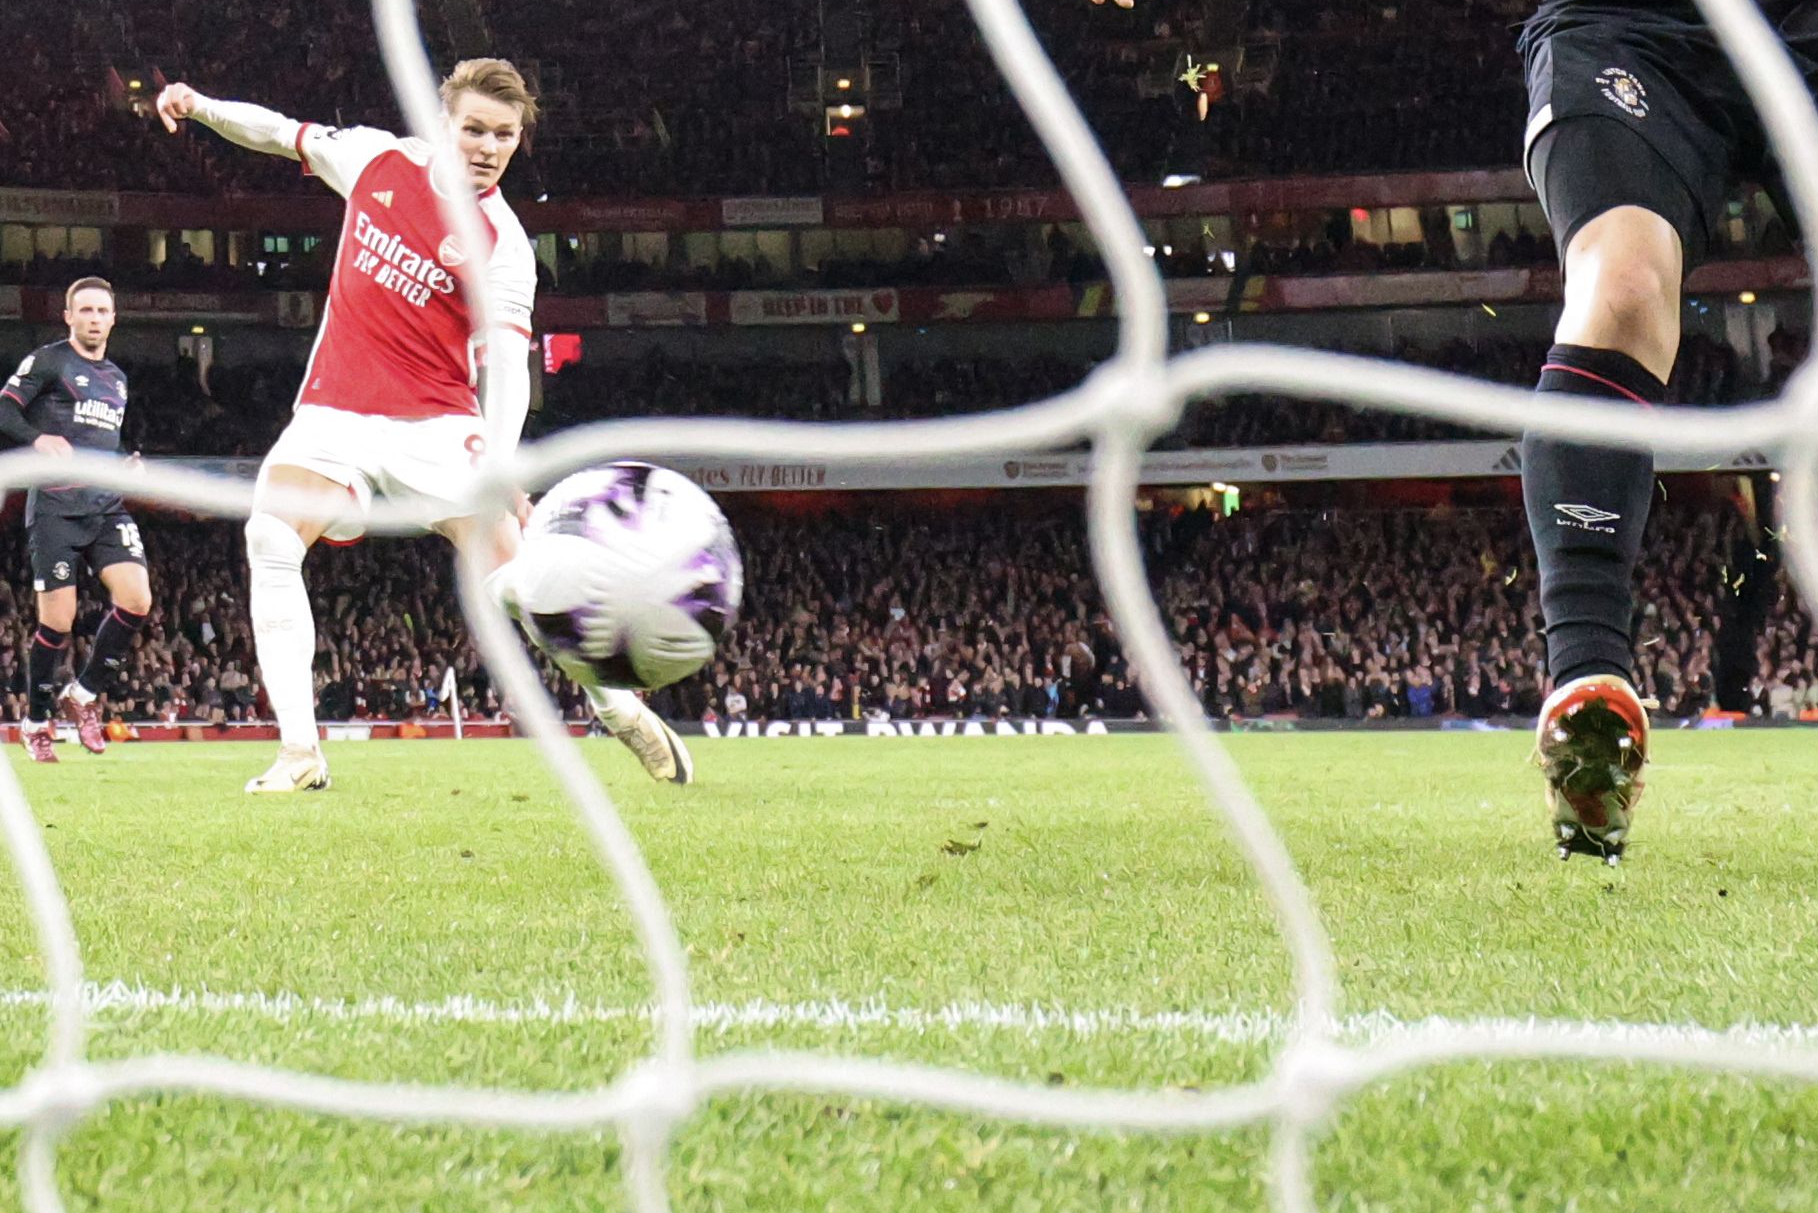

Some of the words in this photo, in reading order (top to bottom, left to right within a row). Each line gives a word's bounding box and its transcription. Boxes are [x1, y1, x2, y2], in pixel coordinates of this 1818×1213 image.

[354, 211, 455, 293] Emirates
[354, 250, 381, 275] FLY
[375, 266, 432, 308] BETTER
[75, 399, 116, 424] utilita
